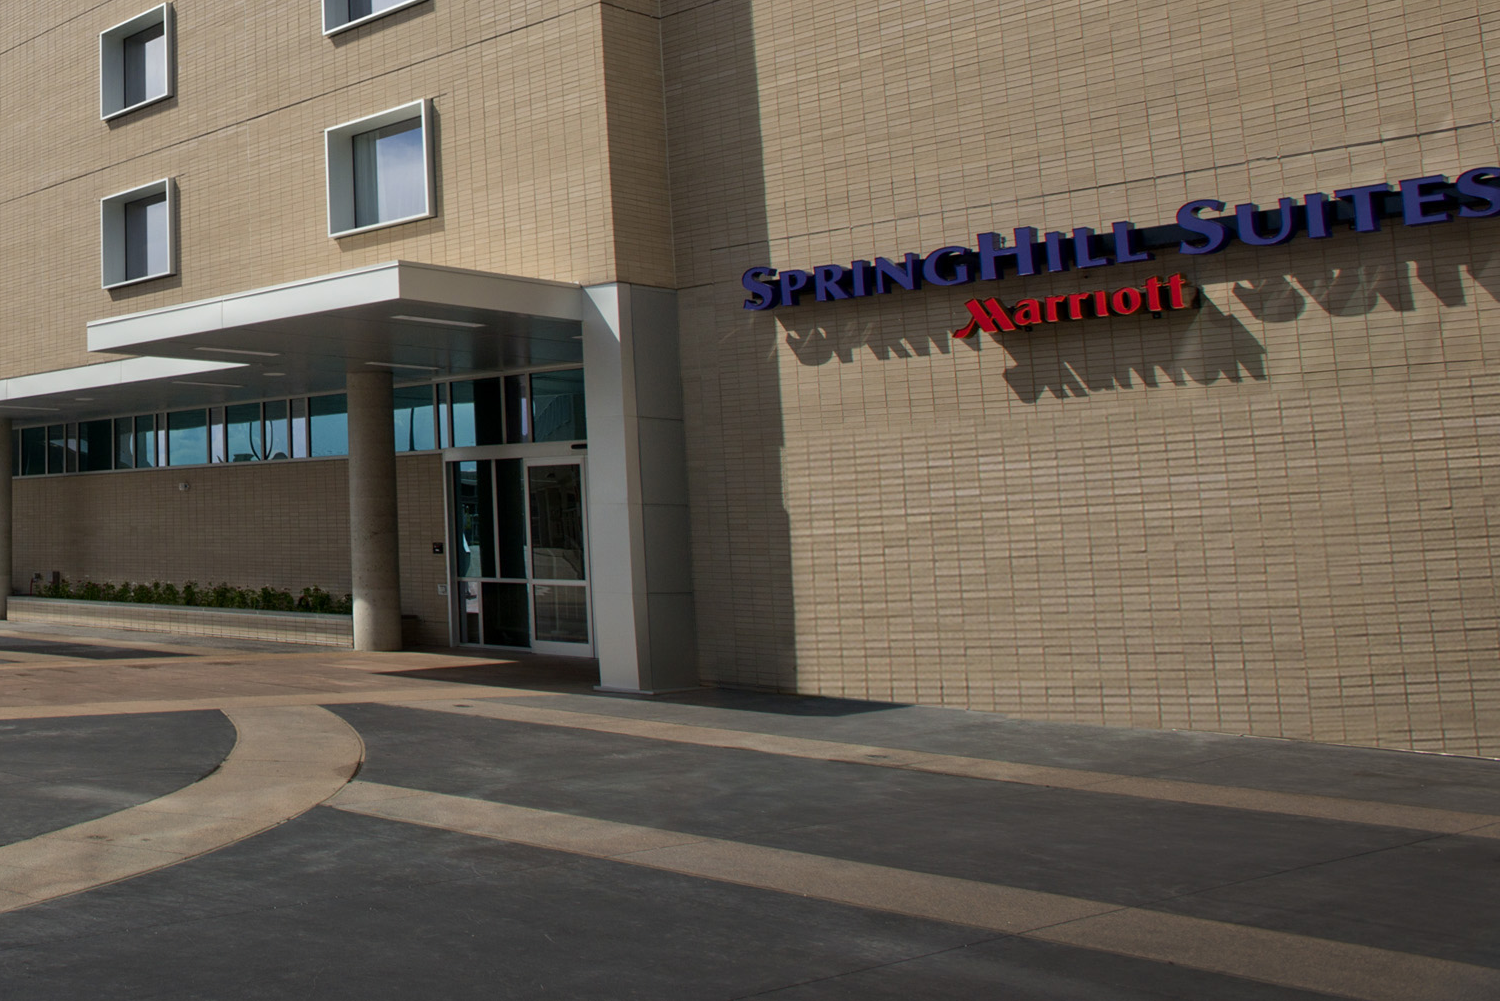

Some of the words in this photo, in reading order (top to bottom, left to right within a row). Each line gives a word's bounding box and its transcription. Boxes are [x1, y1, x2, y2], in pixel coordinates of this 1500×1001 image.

[741, 221, 1155, 311] SPRINGHILL
[1176, 166, 1500, 255] SUITES
[952, 272, 1187, 339] Marriott
